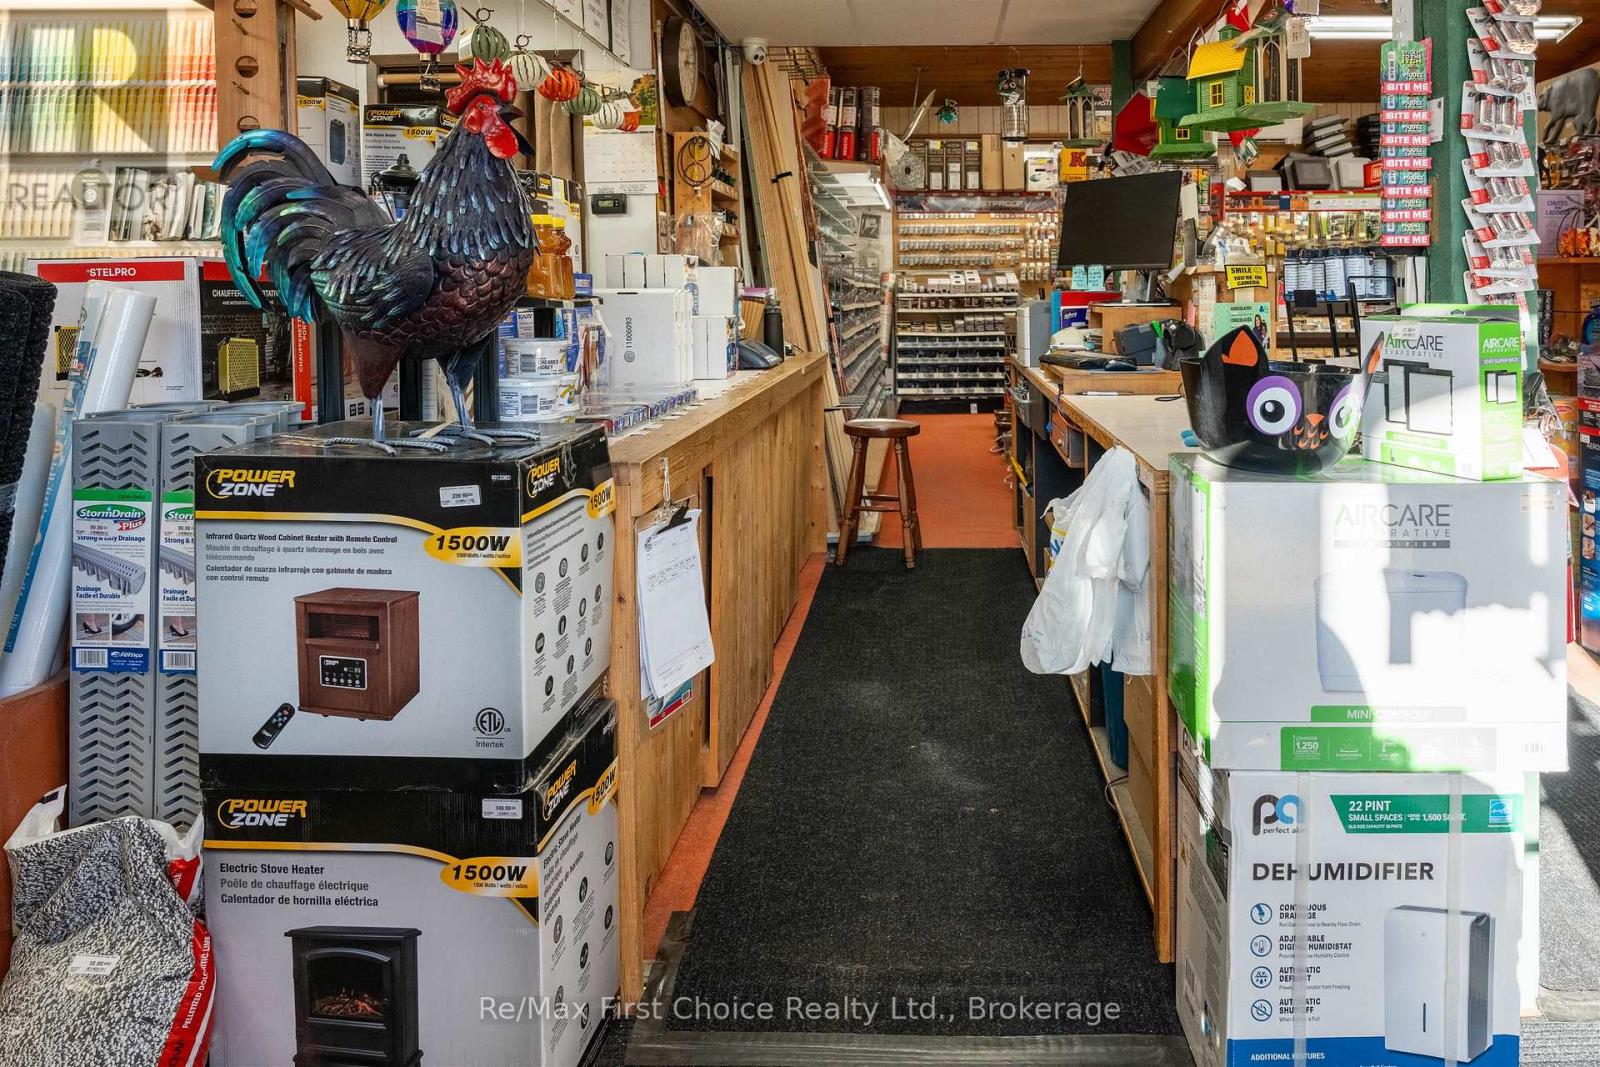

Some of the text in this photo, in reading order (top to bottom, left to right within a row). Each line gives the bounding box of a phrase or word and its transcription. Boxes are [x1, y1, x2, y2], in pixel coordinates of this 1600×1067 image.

[1387, 83, 1428, 91] BITE ME
[371, 109, 401, 118] POWER
[406, 128, 433, 136] 1500W
[1386, 136, 1428, 144] BITE ME
[1069, 152, 1086, 167] K
[1387, 159, 1428, 167] BITE ME
[1387, 187, 1429, 195] BITE ME
[1387, 211, 1428, 219] BITE ME
[89, 267, 136, 277] STELPRO
[1483, 337, 1519, 348] AIRCARE
[530, 457, 560, 481] POWER
[217, 469, 296, 488] POWER
[532, 474, 557, 494] ZONE
[218, 483, 275, 497] ZONE
[589, 486, 612, 510] 1500W
[78, 507, 143, 520] StormDrain
[122, 520, 143, 530] Plus
[118, 535, 146, 543] Drainage
[205, 532, 398, 545] Infrared Quartz Wood Cabinet Heater with Remote Control
[436, 535, 511, 551] 1500W
[205, 565, 242, 573] Calentador
[243, 565, 253, 573] de
[325, 567, 355, 576] gabinete
[356, 568, 365, 576] de
[366, 569, 392, 577] madera
[220, 574, 244, 582] control
[475, 741, 504, 749] Intertek
[547, 761, 576, 800] POWER
[591, 767, 616, 807] 1500W
[228, 799, 307, 818] POWER
[1348, 800, 1391, 811] 22 PINT
[230, 813, 288, 827] ZONE
[1348, 814, 1403, 822] SMALL SPACES
[1422, 813, 1442, 822] 1,500
[1263, 827, 1290, 835] perfect
[220, 863, 325, 875] Electric Stove Heater
[452, 865, 527, 882] 1500W
[1253, 863, 1434, 881] DEHUMIDIFIER
[250, 879, 263, 889] de
[266, 879, 315, 892] chauffage
[318, 880, 369, 893] électrique
[221, 893, 378, 907] Calentador de hornilla eléctrica
[1279, 974, 1312, 982] DEFT
[183, 992, 202, 1029] PELLETIZED
[1250, 1053, 1291, 1061] ADDITIONAL
